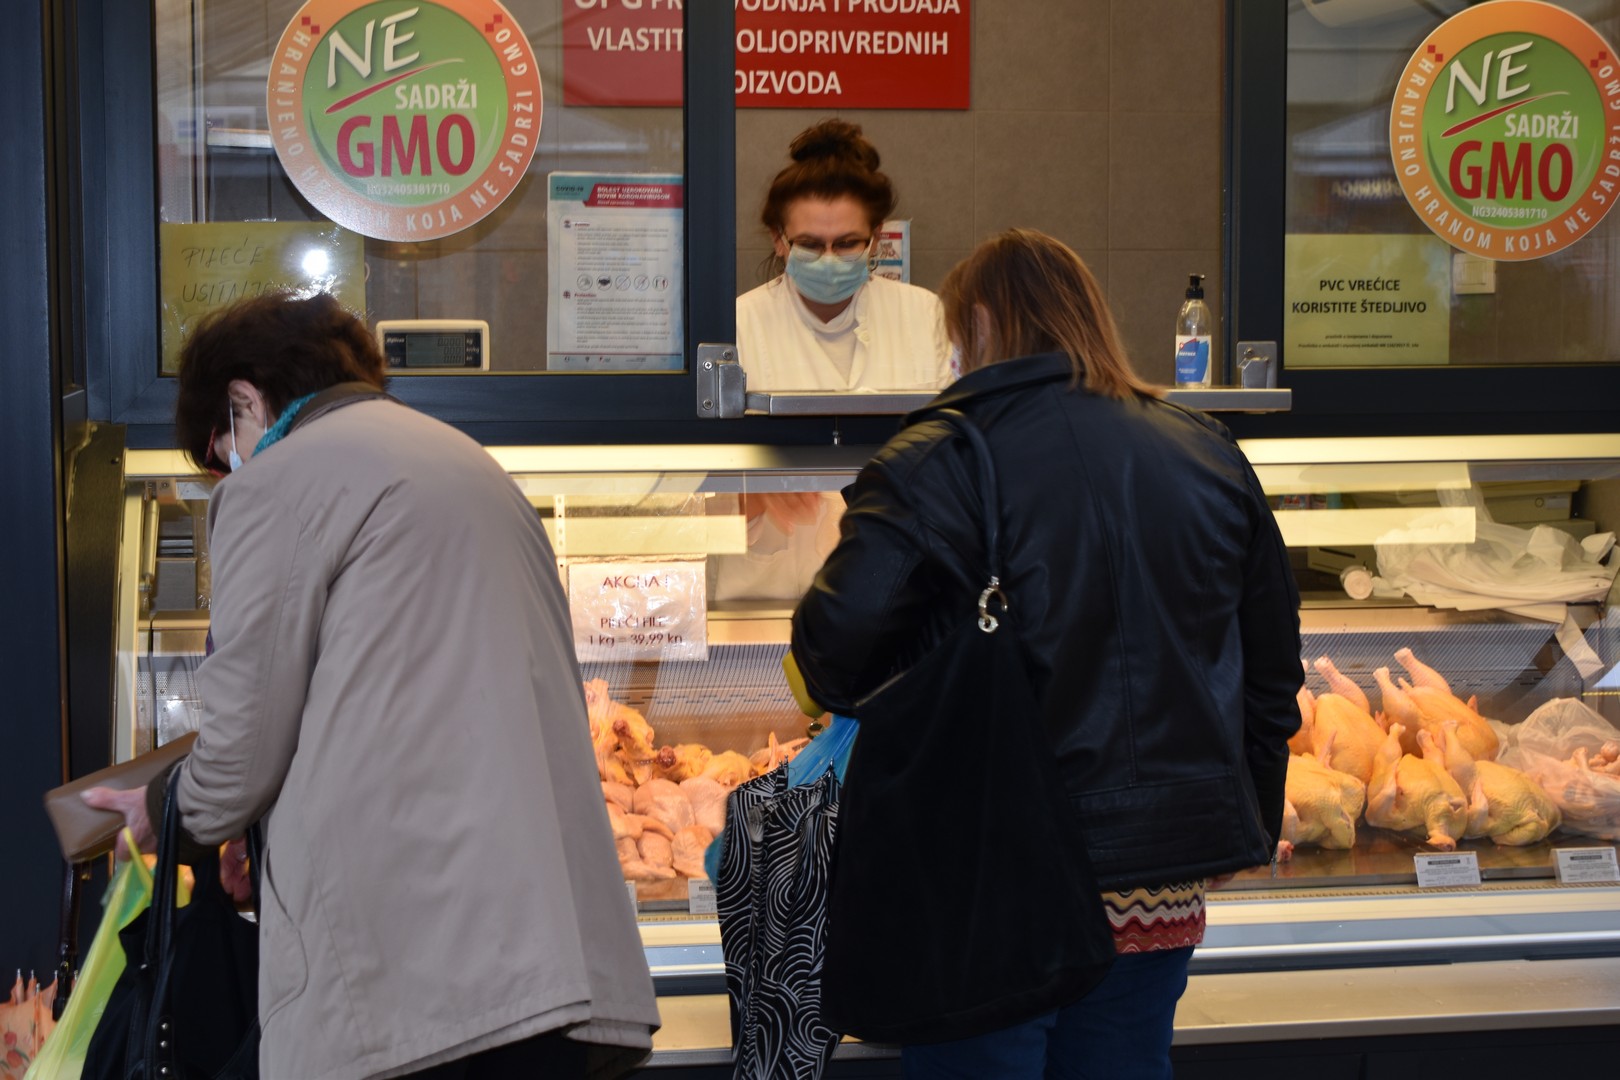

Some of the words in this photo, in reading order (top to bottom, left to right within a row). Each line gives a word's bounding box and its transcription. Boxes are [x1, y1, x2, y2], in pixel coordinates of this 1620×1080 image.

[327, 7, 420, 88] NE
[495, 28, 527, 76] GMO
[587, 28, 684, 51] VLASTIT
[736, 29, 949, 55] OLJOPRIVREDNIH
[735, 70, 842, 94] OIZVODA
[1445, 41, 1533, 113] NE
[277, 31, 311, 157] HRANJENO
[395, 79, 477, 110] SADRŽI
[1399, 58, 1434, 176] HRANJENO
[1505, 111, 1579, 139] SADRŽI
[337, 114, 476, 178] GMO
[499, 90, 532, 176] SADRŽI
[1449, 140, 1573, 202] GMO
[470, 180, 499, 208] NE
[406, 205, 463, 232] KOJA
[1416, 185, 1491, 249] HRANOM
[1472, 205, 1548, 219] NG32405381710
[1564, 208, 1591, 233] NE
[1505, 229, 1557, 252] KOJA
[1319, 280, 1345, 291] PVC
[1348, 276, 1400, 291] VREĆICE
[1292, 301, 1357, 313] KORISTITE
[1360, 299, 1427, 313] ŠTEDLJIVO
[599, 635, 615, 647] kg
[630, 633, 664, 646] 39,99
[667, 633, 683, 644] kn
